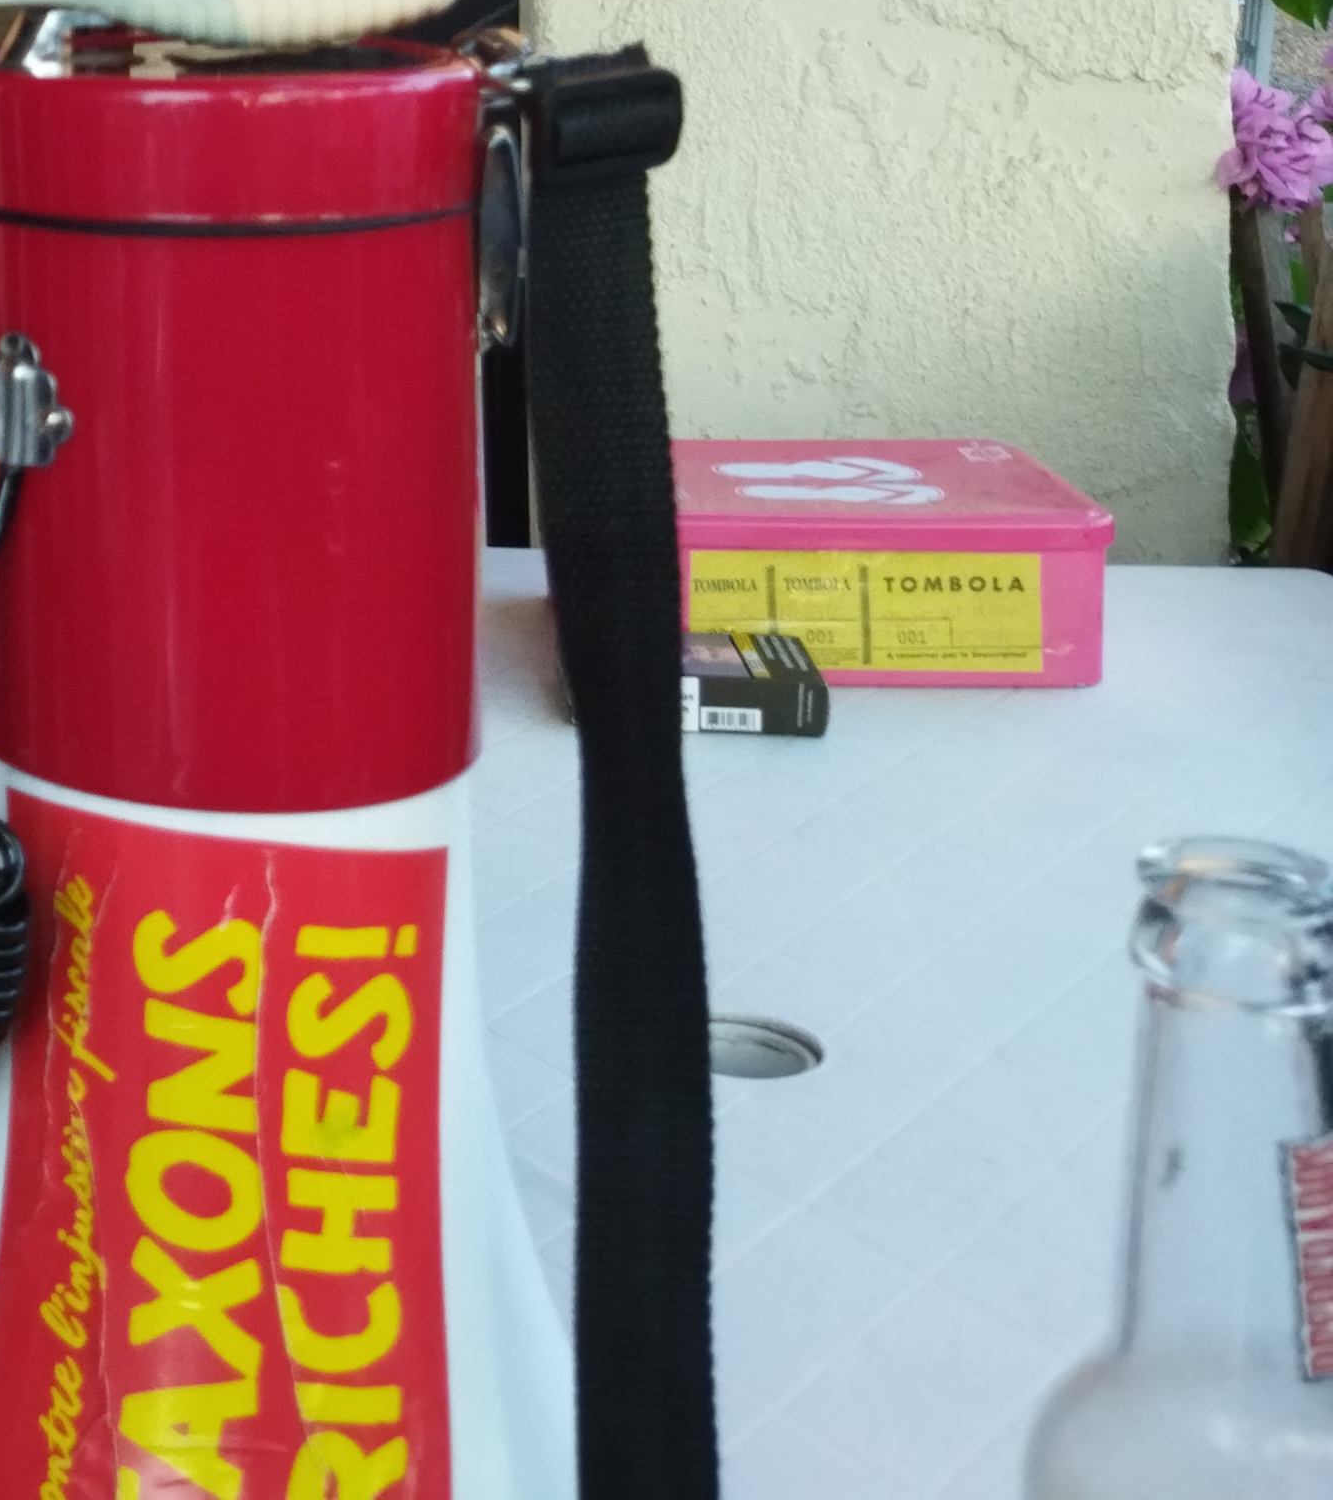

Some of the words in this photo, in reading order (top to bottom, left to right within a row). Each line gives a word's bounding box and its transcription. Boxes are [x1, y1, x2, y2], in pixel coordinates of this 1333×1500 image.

[693, 577, 759, 593] TOMBOLA
[783, 576, 852, 592] TOMBOLA
[883, 575, 1026, 594] TOMBOLA
[806, 628, 835, 645] 001
[897, 629, 927, 646] 001
[53, 874, 117, 1083] fiscale
[117, 908, 264, 1500] AXONS
